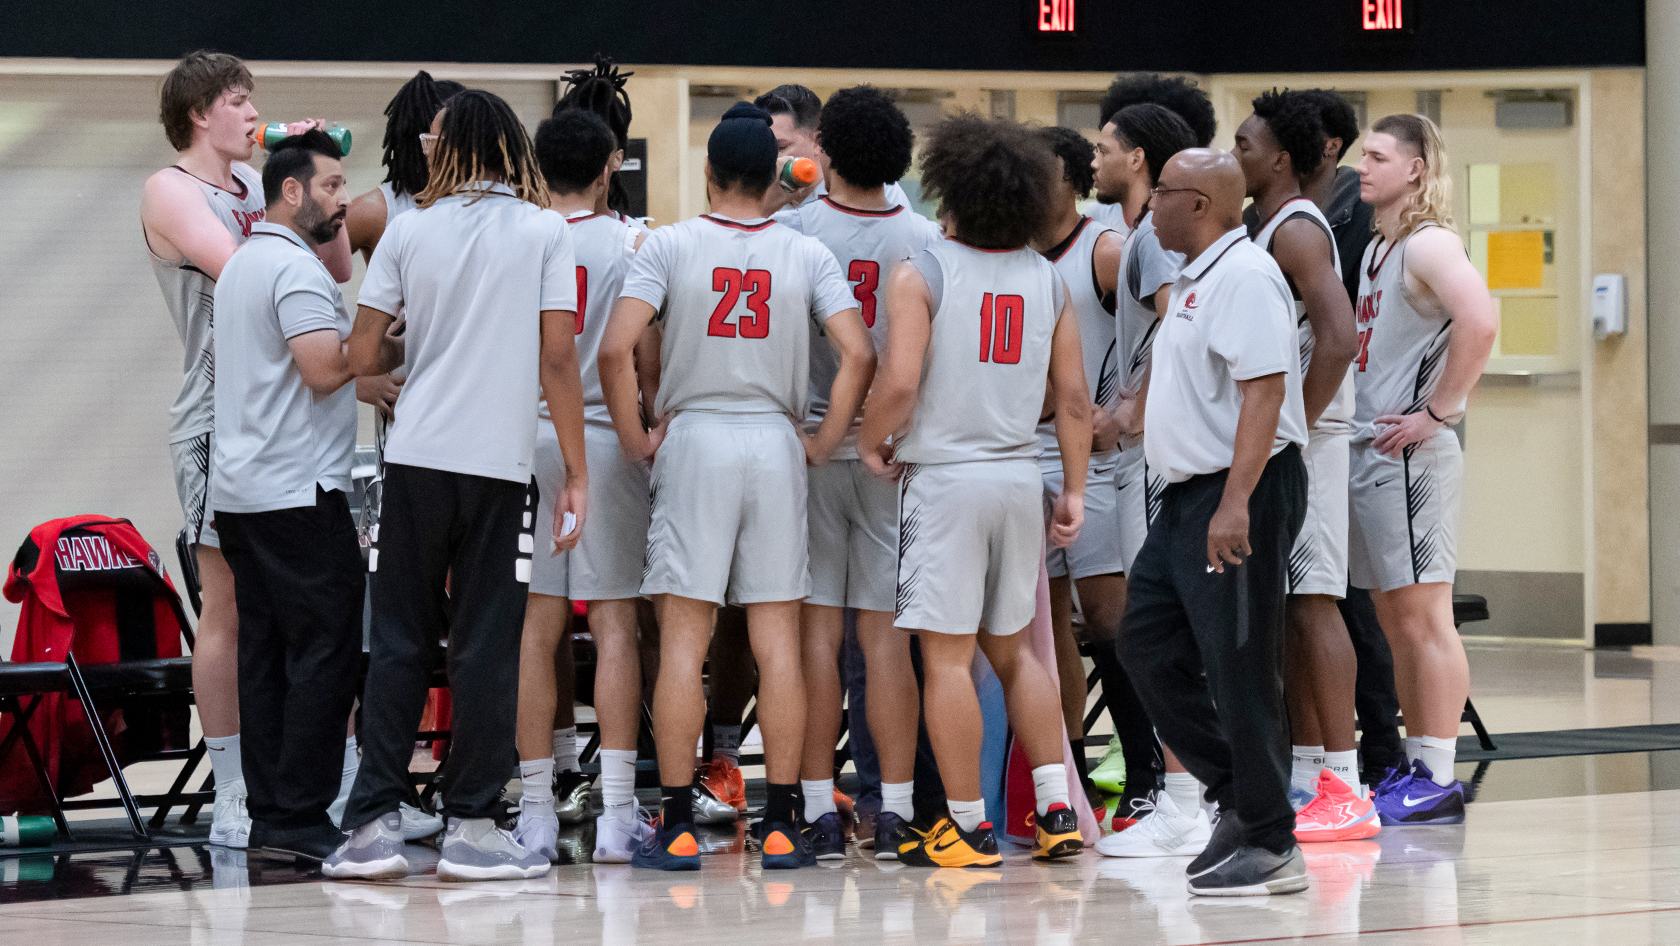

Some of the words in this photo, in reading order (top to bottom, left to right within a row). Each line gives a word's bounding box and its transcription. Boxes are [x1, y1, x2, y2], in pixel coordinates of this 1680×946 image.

[707, 267, 772, 339] 23
[979, 292, 1024, 364] 10
[55, 536, 144, 571] HAWK
